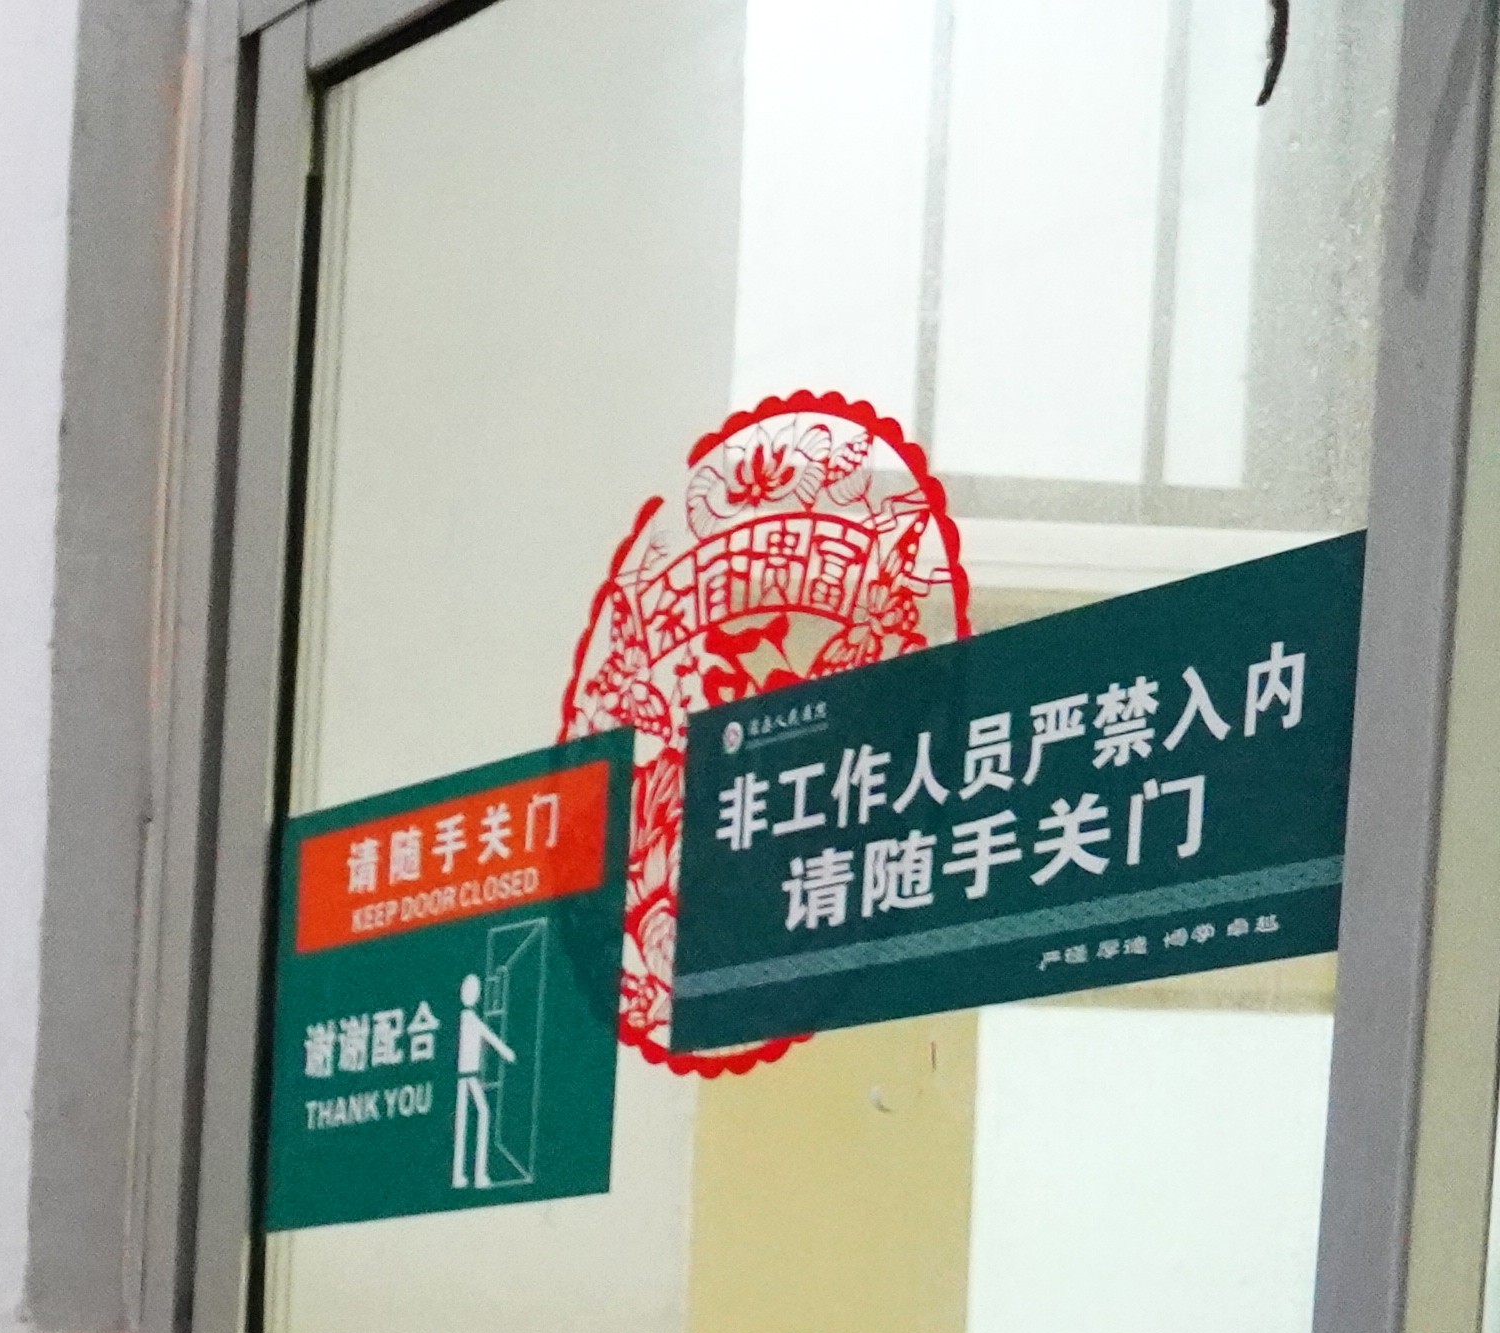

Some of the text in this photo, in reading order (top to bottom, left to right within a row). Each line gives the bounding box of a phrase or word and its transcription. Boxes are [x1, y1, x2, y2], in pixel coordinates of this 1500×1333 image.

[716, 641, 1306, 852] 非工作人员严禁入内
[346, 793, 561, 895] 请随手关门
[781, 774, 1206, 932] 请随手关门
[351, 867, 540, 934] KEEP DOOR CLOSED
[304, 1001, 442, 1078] 谢谢配合
[304, 1082, 433, 1130] THANK YOU
